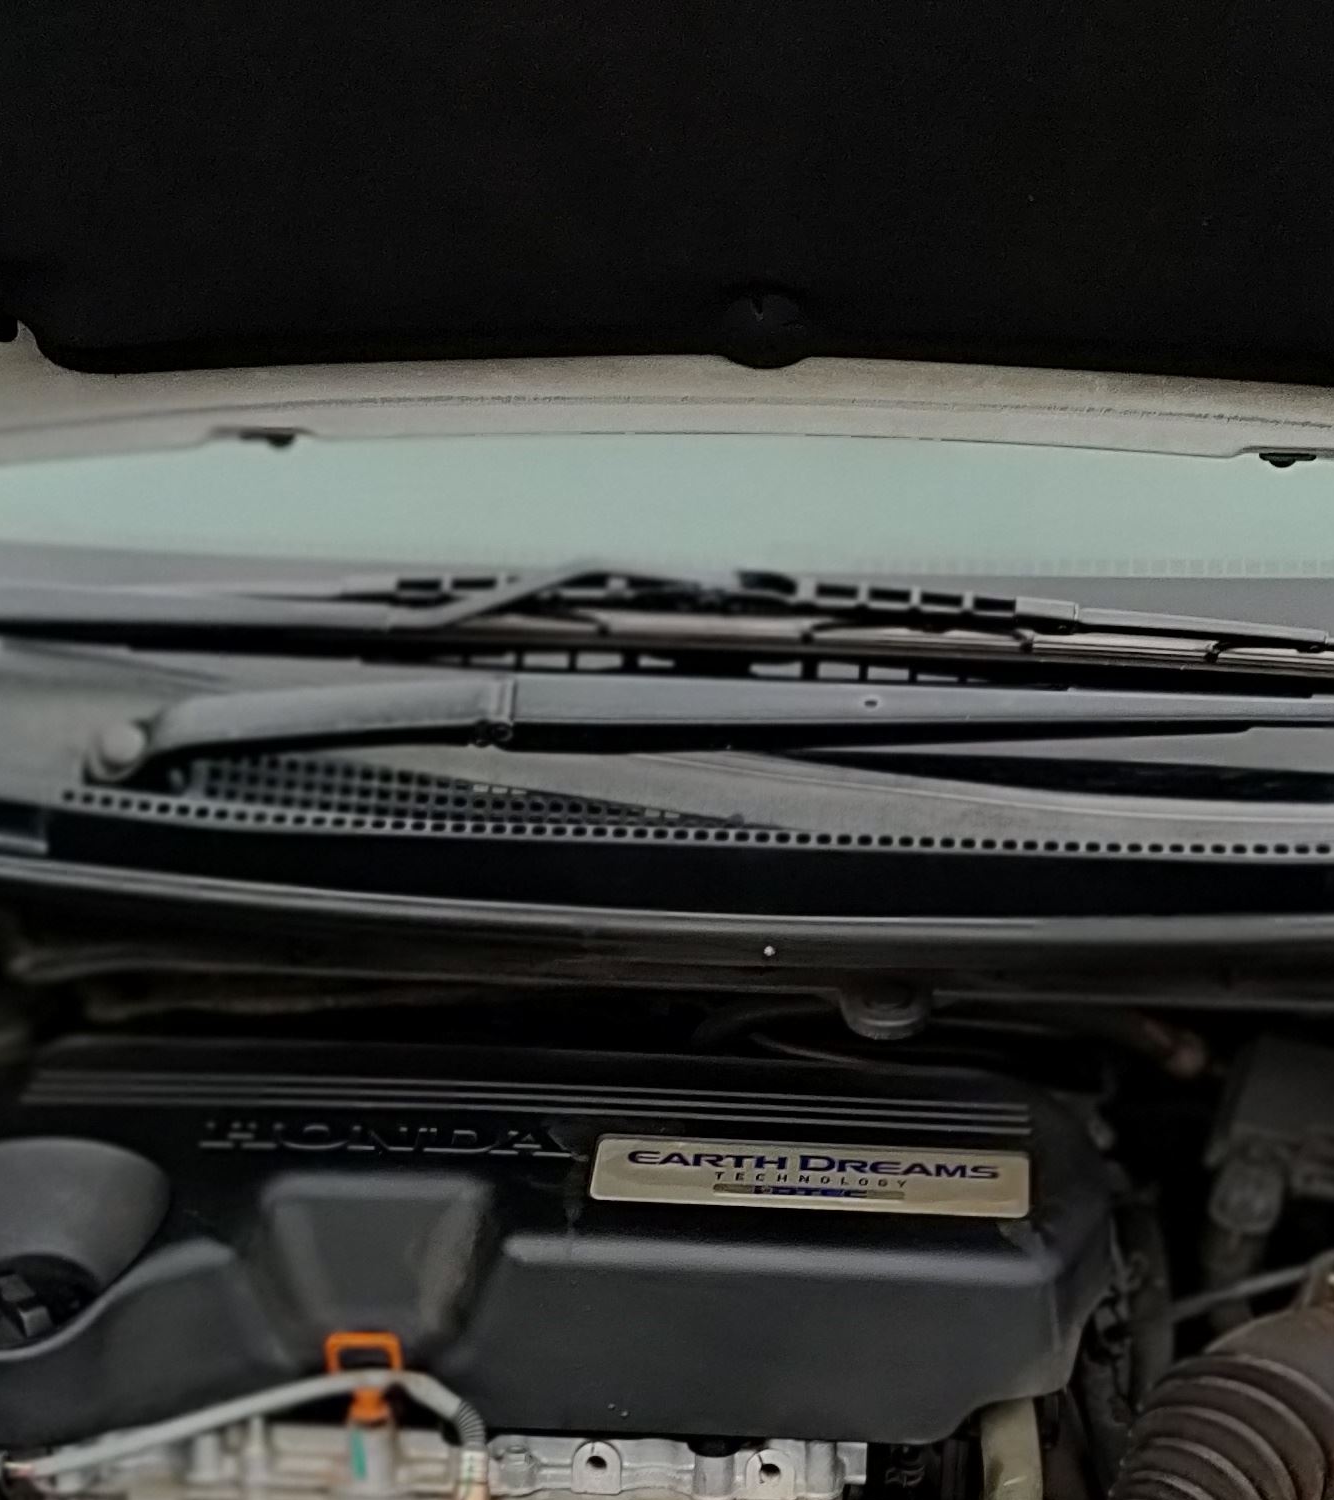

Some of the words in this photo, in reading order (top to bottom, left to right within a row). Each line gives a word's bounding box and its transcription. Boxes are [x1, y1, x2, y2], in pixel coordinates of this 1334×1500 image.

[627, 1150, 788, 1171] EARTH
[798, 1154, 1000, 1181] DREAMS
[714, 1170, 908, 1189] TECHNOLOGY
